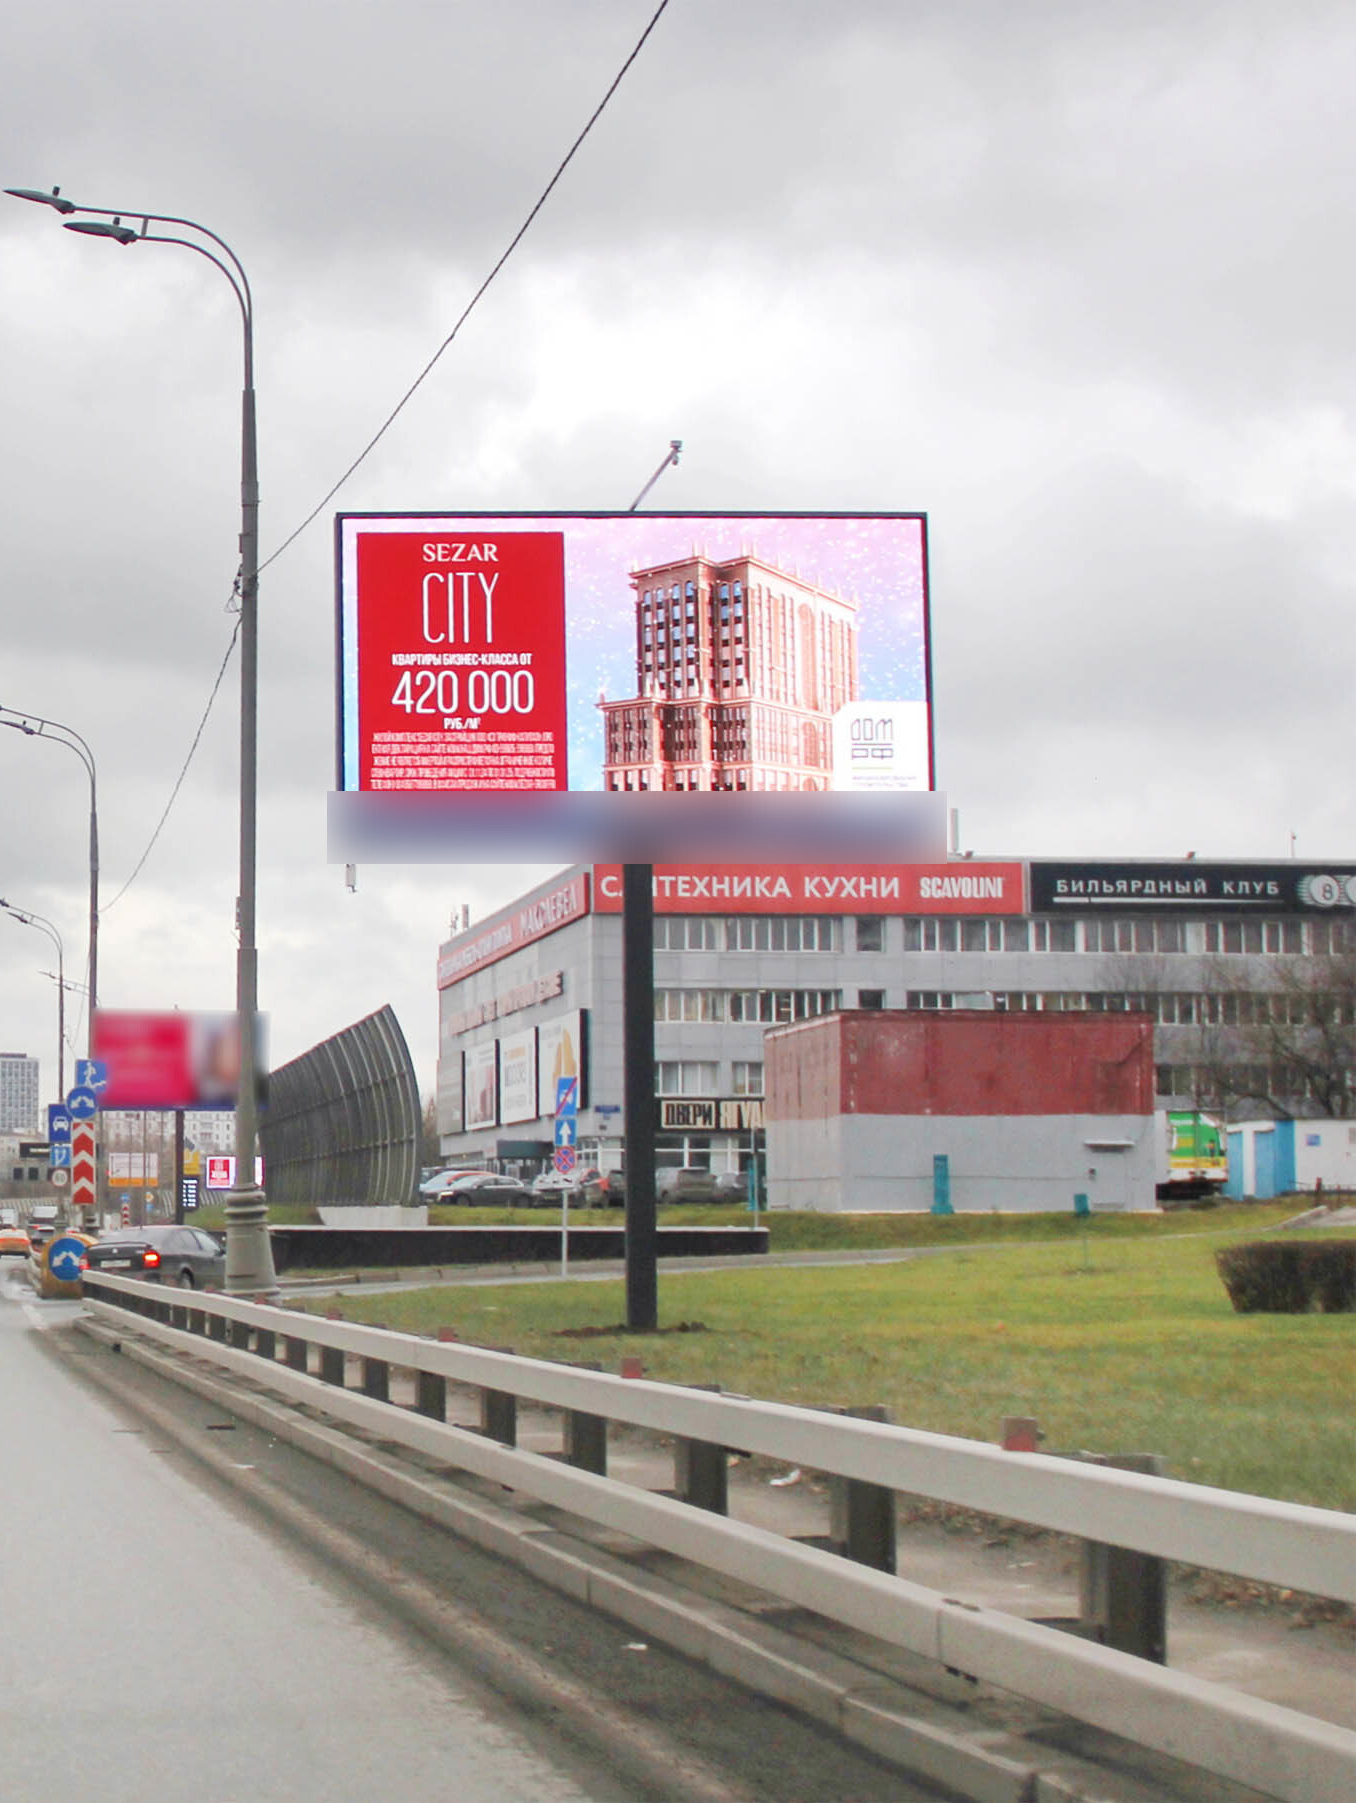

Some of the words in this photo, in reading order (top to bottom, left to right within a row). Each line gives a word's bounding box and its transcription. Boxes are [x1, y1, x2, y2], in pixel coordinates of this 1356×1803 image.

[422, 543, 499, 562] SEZAR
[422, 572, 499, 643] CITY
[392, 653, 441, 665] КВАРТИРЫ
[442, 653, 518, 665] БИЗНЕС-КЛАССА
[519, 653, 532, 665] ОТ
[391, 670, 458, 714] 420
[468, 670, 534, 714] 000
[804, 876, 900, 898] КУХНИ
[920, 876, 1003, 898] SCAVOLINI
[1056, 878, 1208, 895] БИЛЬЯРДНЫЙ
[1223, 880, 1280, 896] КЛУБ
[665, 1103, 712, 1126] ДВЕРИ
